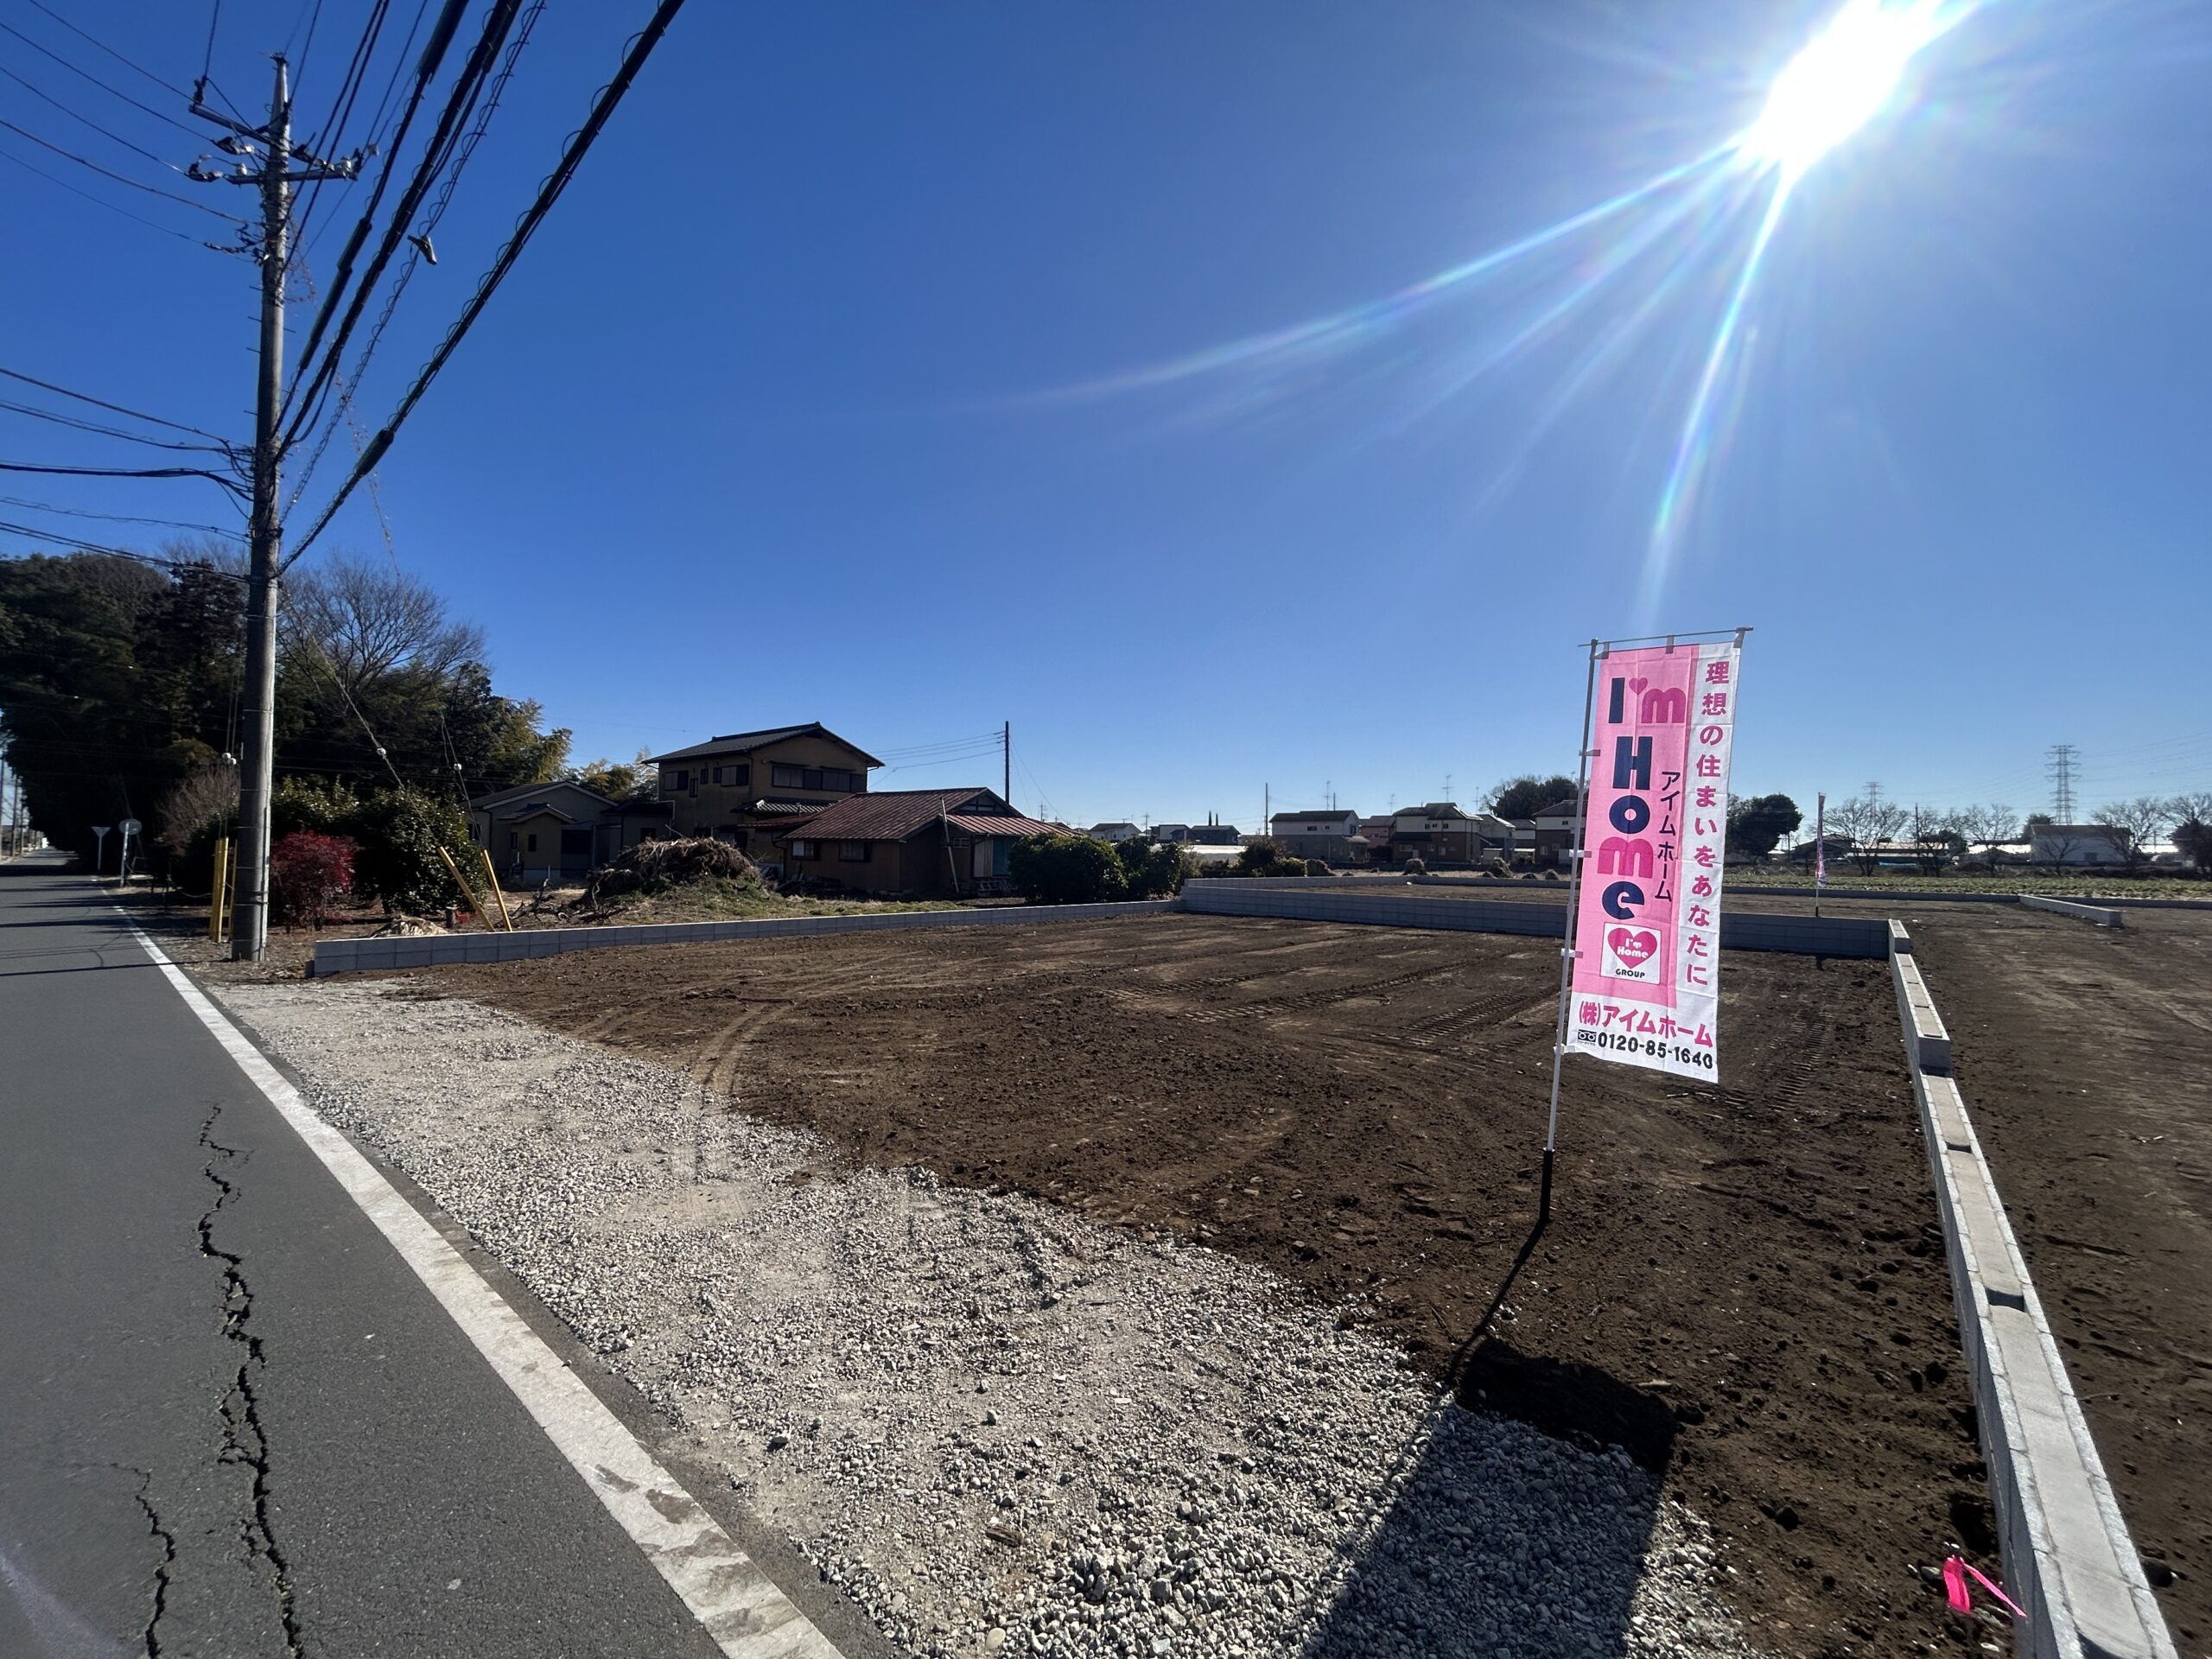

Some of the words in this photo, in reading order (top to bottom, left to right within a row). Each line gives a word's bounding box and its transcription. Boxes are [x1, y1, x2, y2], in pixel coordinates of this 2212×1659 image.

[1655, 771, 1681, 902] アイムホーム
[1687, 661, 1730, 986] 理想の住まいをあなたに
[1617, 945, 1649, 959] Home
[1615, 968, 1645, 978] GROUP
[1598, 1032, 1713, 1070] 0120-85-1640
